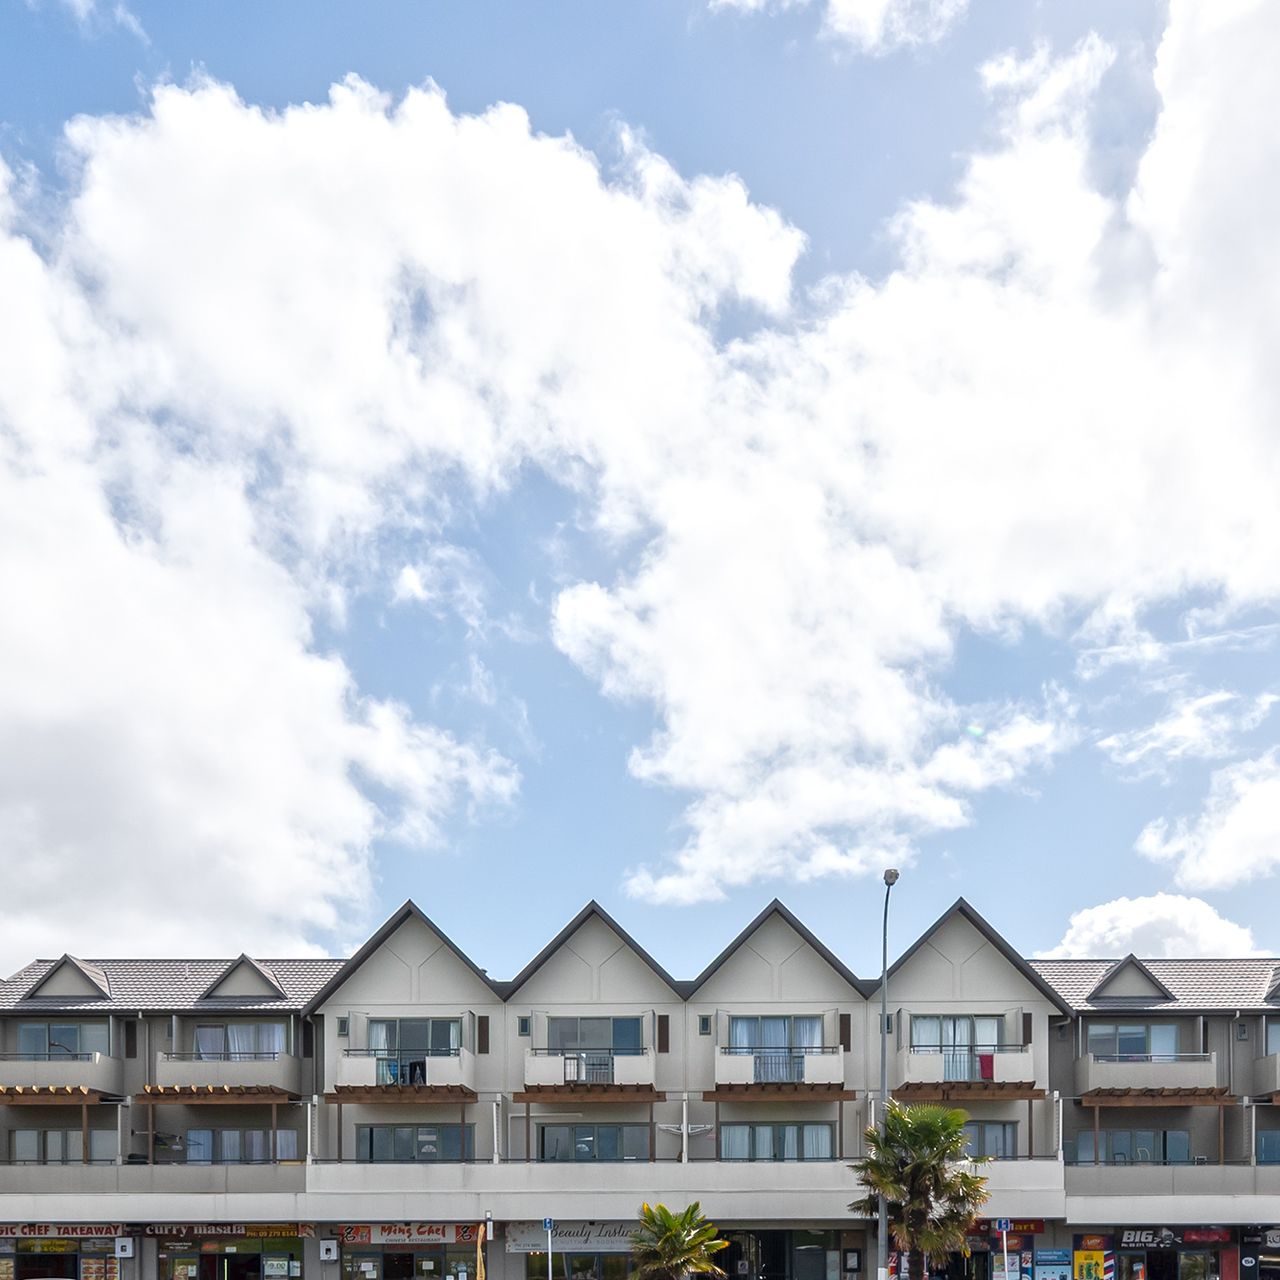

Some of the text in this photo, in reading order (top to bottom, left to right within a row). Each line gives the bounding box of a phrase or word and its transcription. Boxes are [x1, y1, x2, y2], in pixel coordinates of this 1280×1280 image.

[20, 1225, 50, 1235] CHEF
[56, 1225, 120, 1235] TAKEAWAY
[145, 1225, 187, 1237] curry
[193, 1224, 246, 1234] masala
[381, 1224, 446, 1238] Ming Chef
[551, 1224, 644, 1243] Beauty Instit
[1122, 1231, 1154, 1243] BIG
